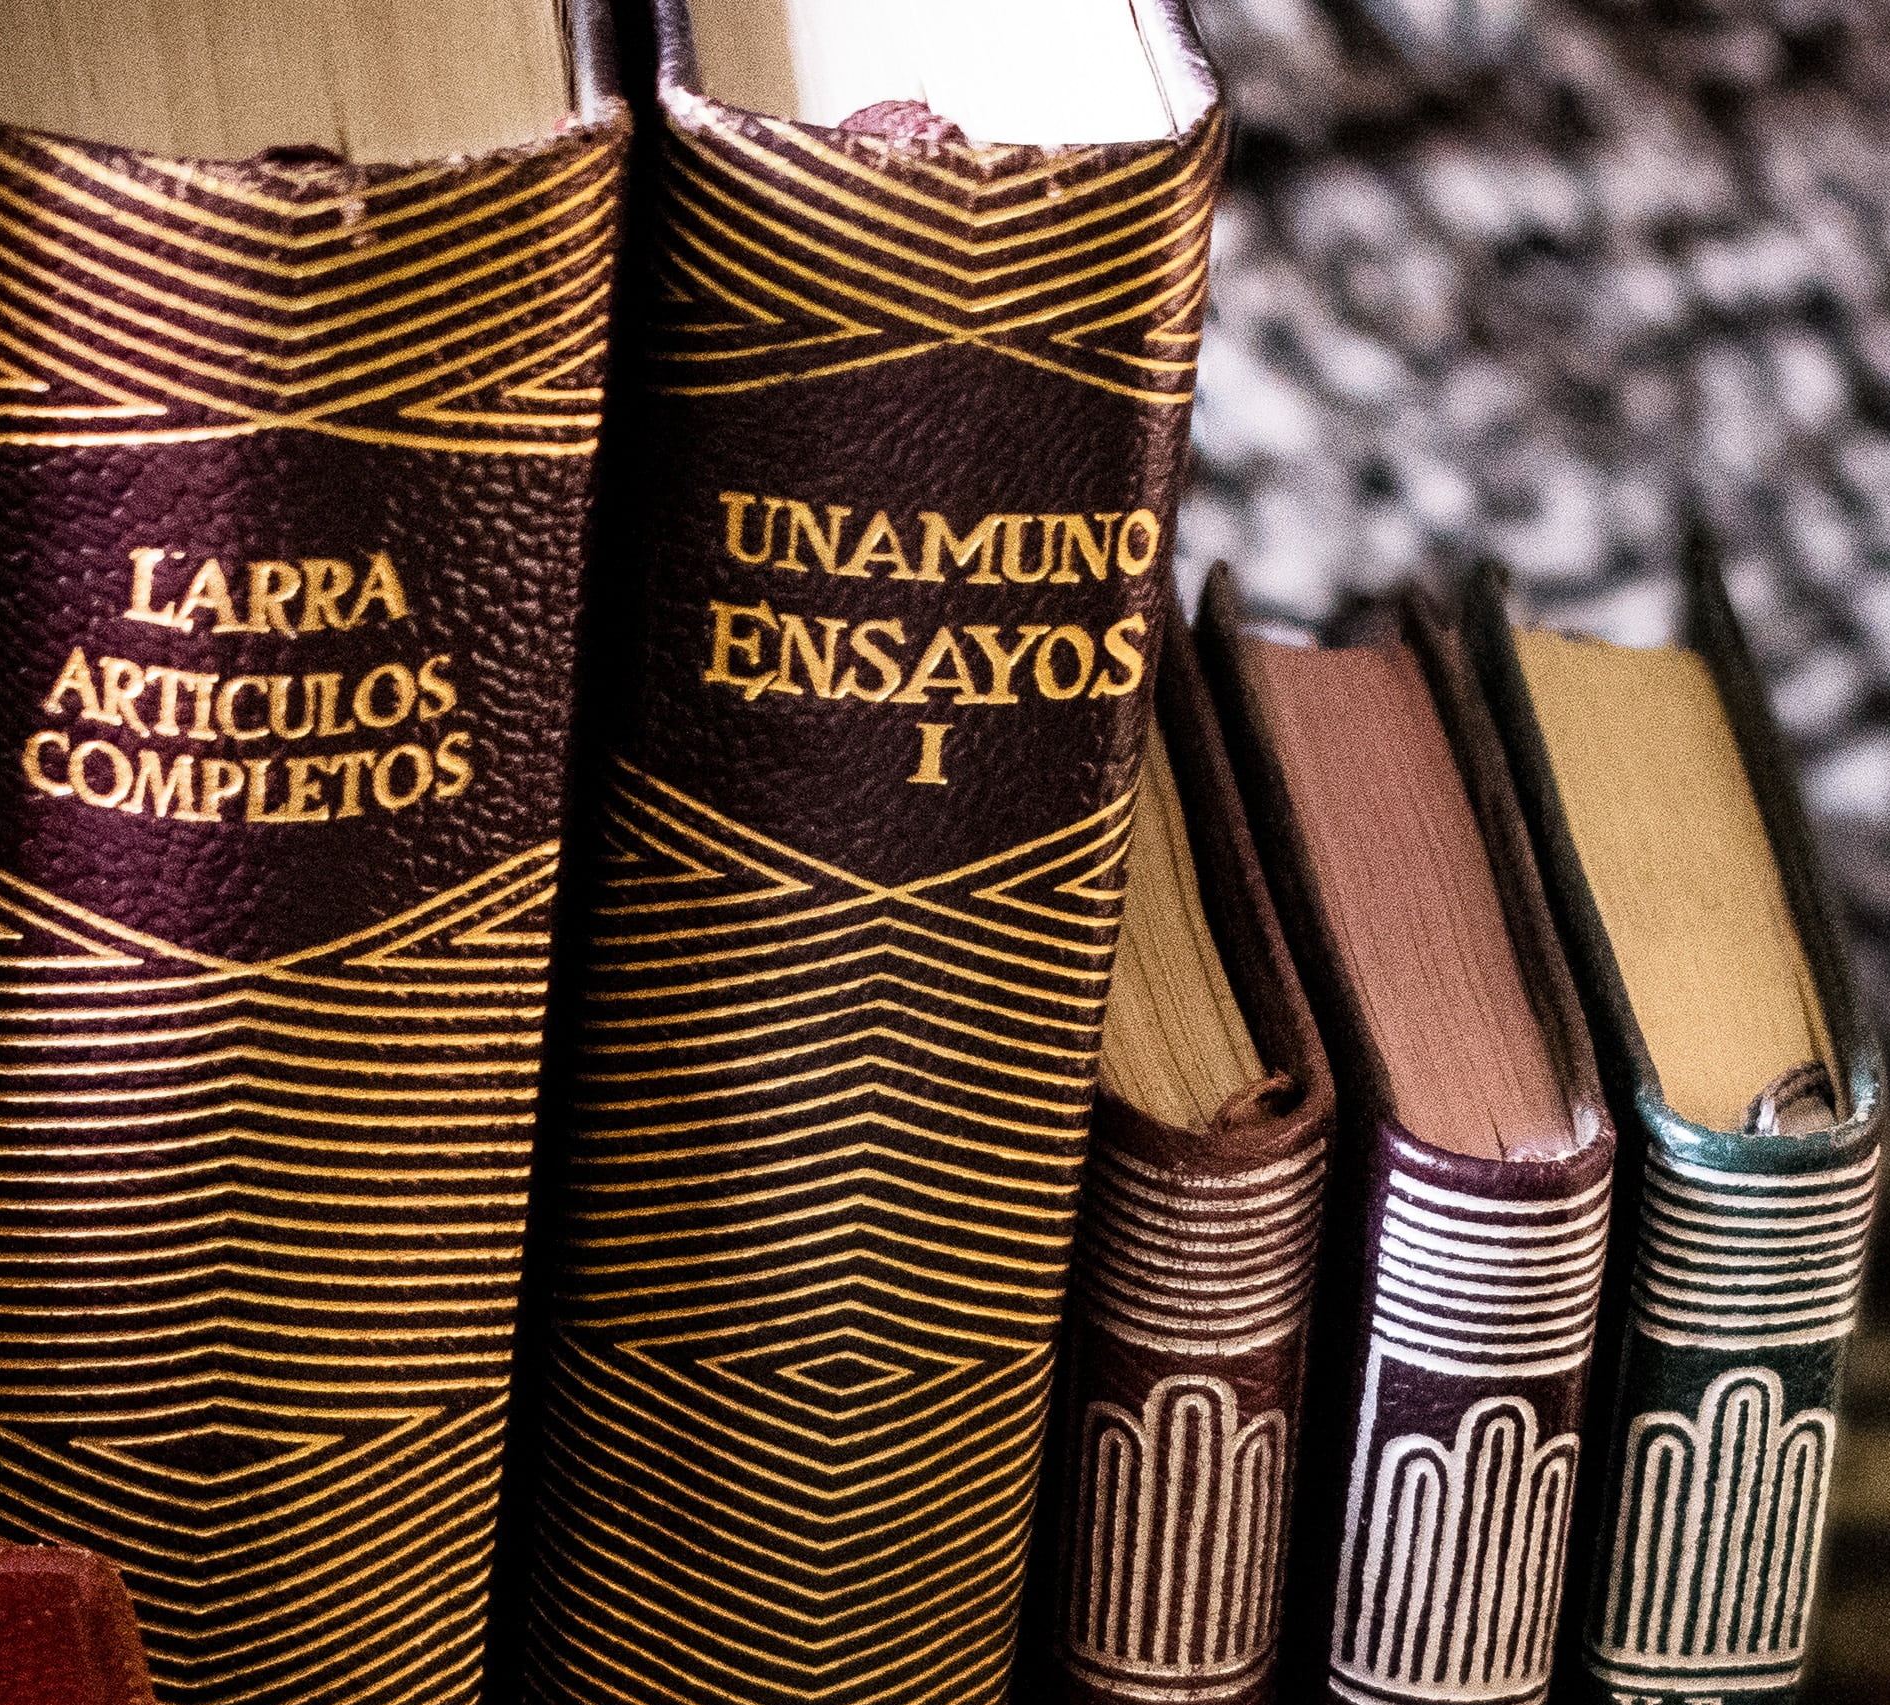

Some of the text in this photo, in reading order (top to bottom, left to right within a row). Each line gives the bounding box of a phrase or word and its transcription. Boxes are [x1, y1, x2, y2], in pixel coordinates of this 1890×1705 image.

[719, 490, 1161, 585] UNAMUNO
[123, 546, 410, 639] LARRA
[43, 645, 458, 741] ARTICULOS
[703, 598, 1148, 704] ENSAYOS
[22, 730, 474, 823] COMPLETOS
[906, 721, 955, 785] I
